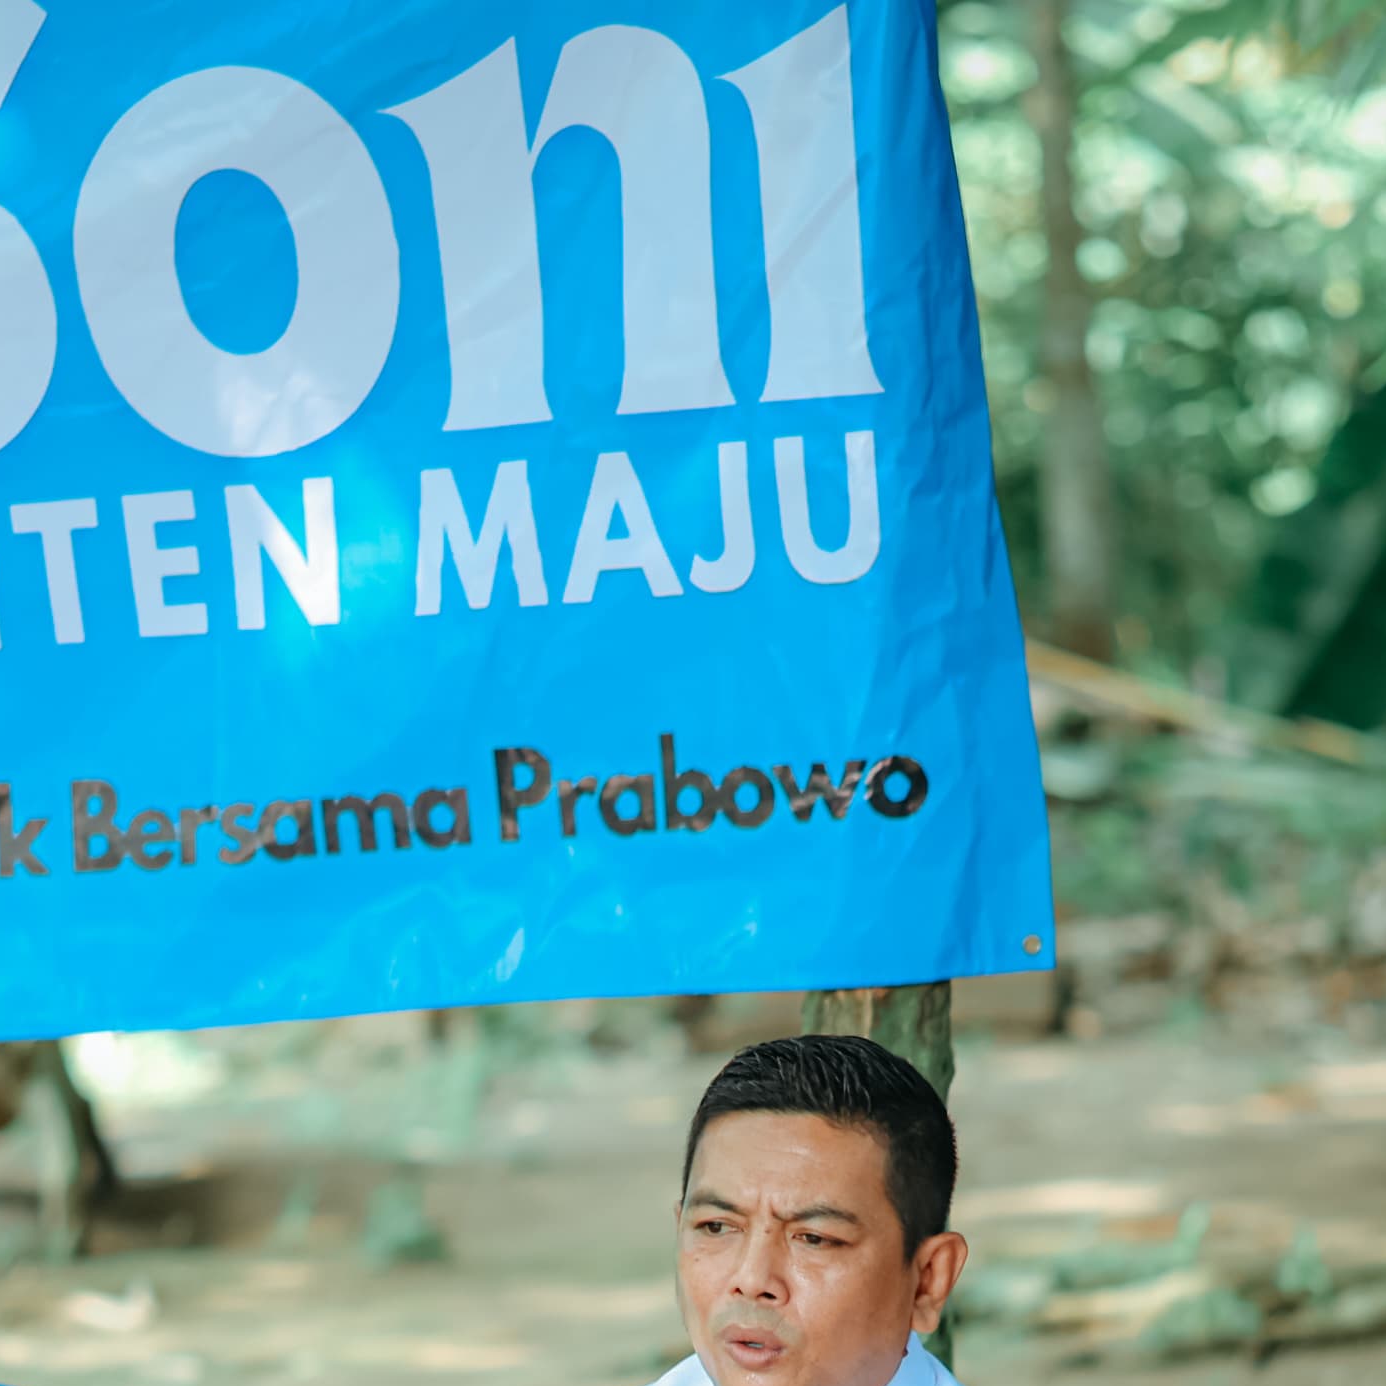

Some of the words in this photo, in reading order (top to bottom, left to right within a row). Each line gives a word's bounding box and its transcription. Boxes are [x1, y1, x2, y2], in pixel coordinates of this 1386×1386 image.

[415, 430, 880, 617] MAJU
[72, 781, 471, 872] Bersama
[496, 733, 929, 842] Prabowo
